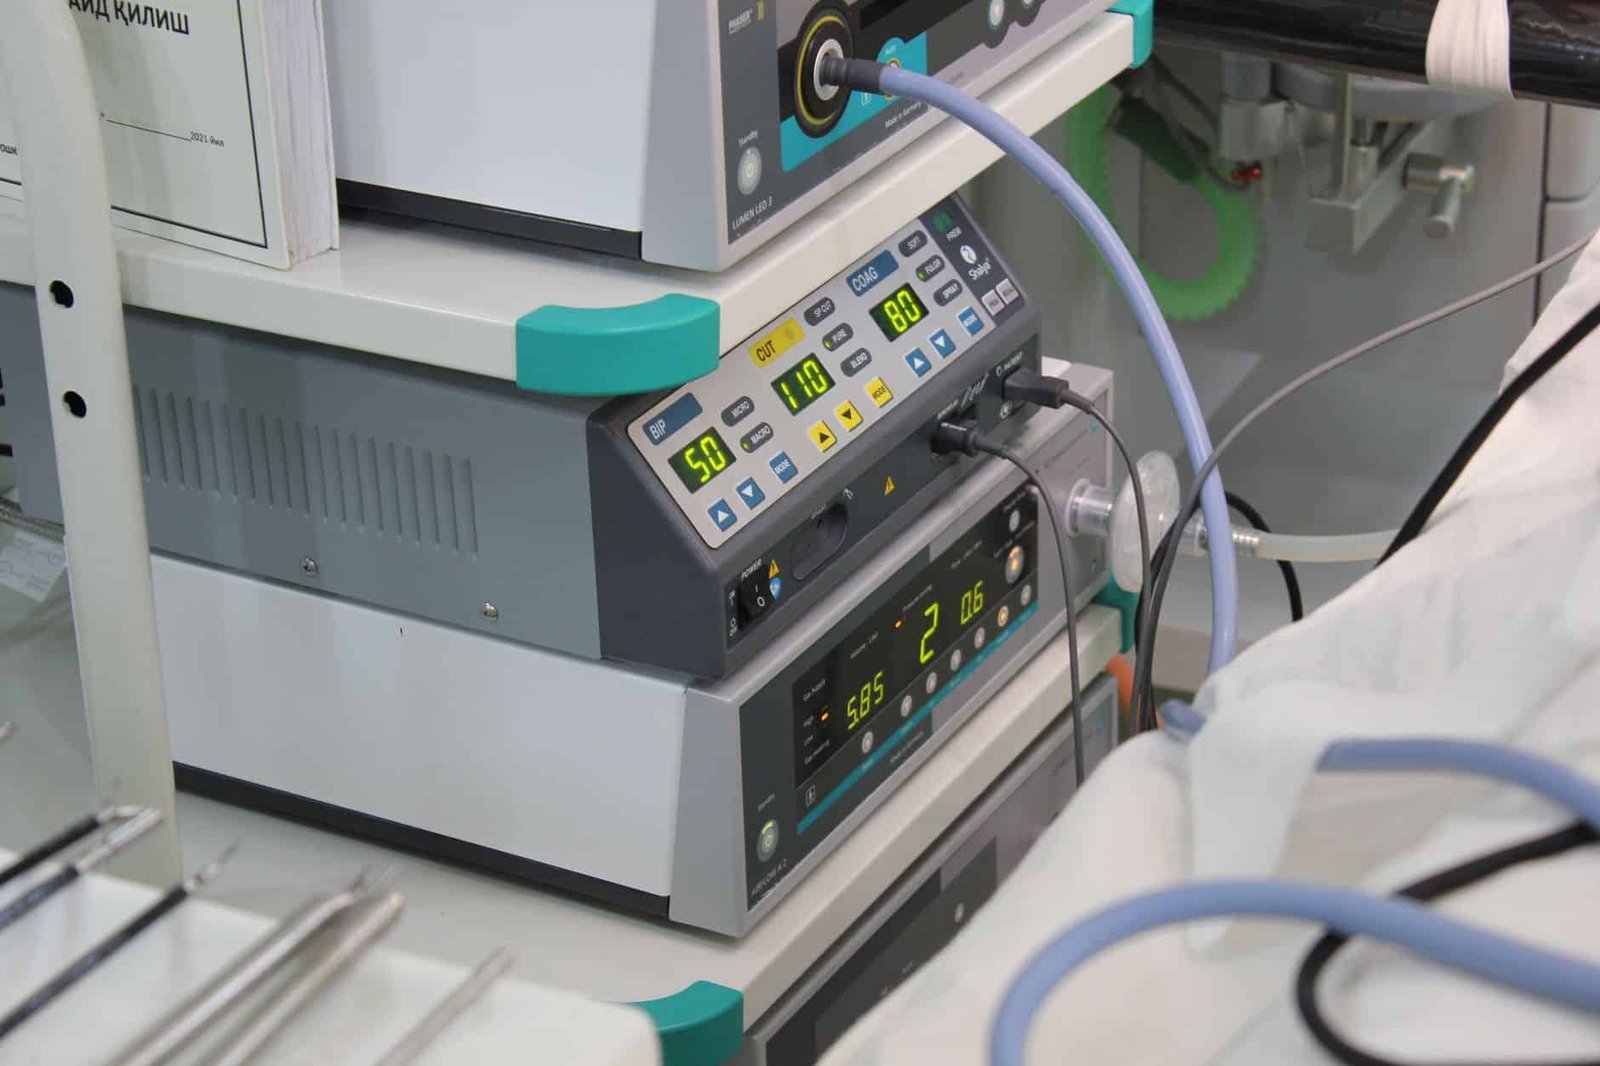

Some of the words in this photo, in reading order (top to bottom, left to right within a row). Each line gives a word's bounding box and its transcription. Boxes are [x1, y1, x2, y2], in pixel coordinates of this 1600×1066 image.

[114, 0, 189, 35] ҚИЛИШ
[190, 131, 208, 143] 2021
[732, 208, 754, 230] LUMEN
[852, 267, 879, 291] COAG
[884, 289, 921, 333] 80
[756, 340, 776, 362] CUT
[781, 360, 828, 409] 110
[731, 401, 750, 418] MICRO
[650, 419, 667, 440] BIP
[750, 426, 771, 444] MACRO
[685, 436, 727, 482] 50
[774, 458, 791, 474] MODE
[741, 558, 762, 579] POWER
[919, 602, 939, 664] 2
